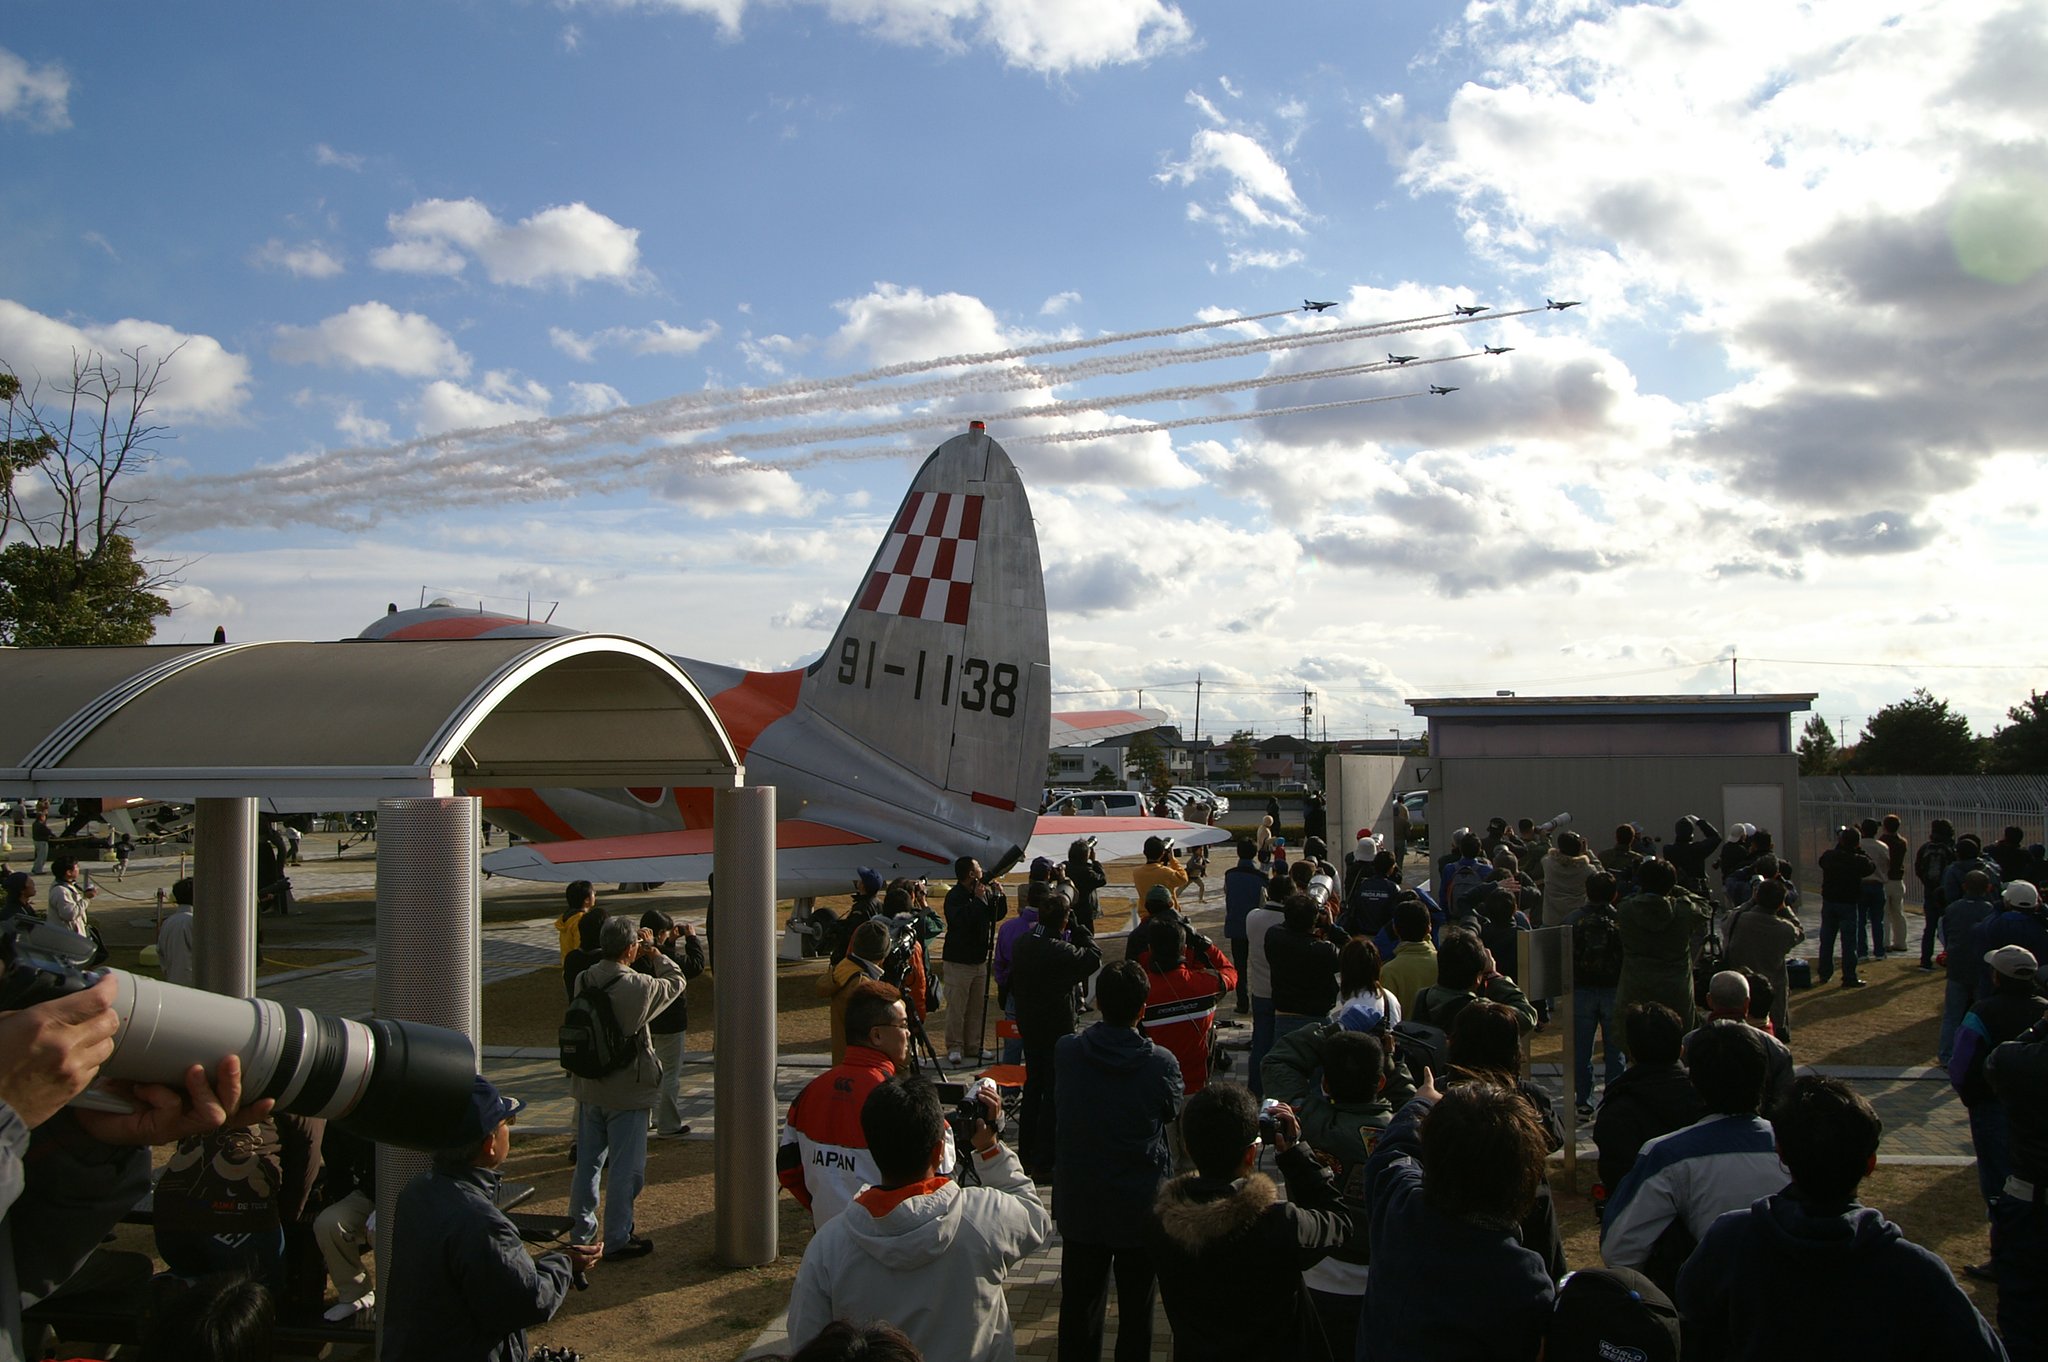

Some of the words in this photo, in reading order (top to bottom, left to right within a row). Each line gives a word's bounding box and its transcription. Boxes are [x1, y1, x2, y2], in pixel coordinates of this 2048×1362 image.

[837, 636, 1020, 718] 91-1138
[812, 1148, 856, 1172] JAPAN
[1601, 1342, 1642, 1361] WORLD
